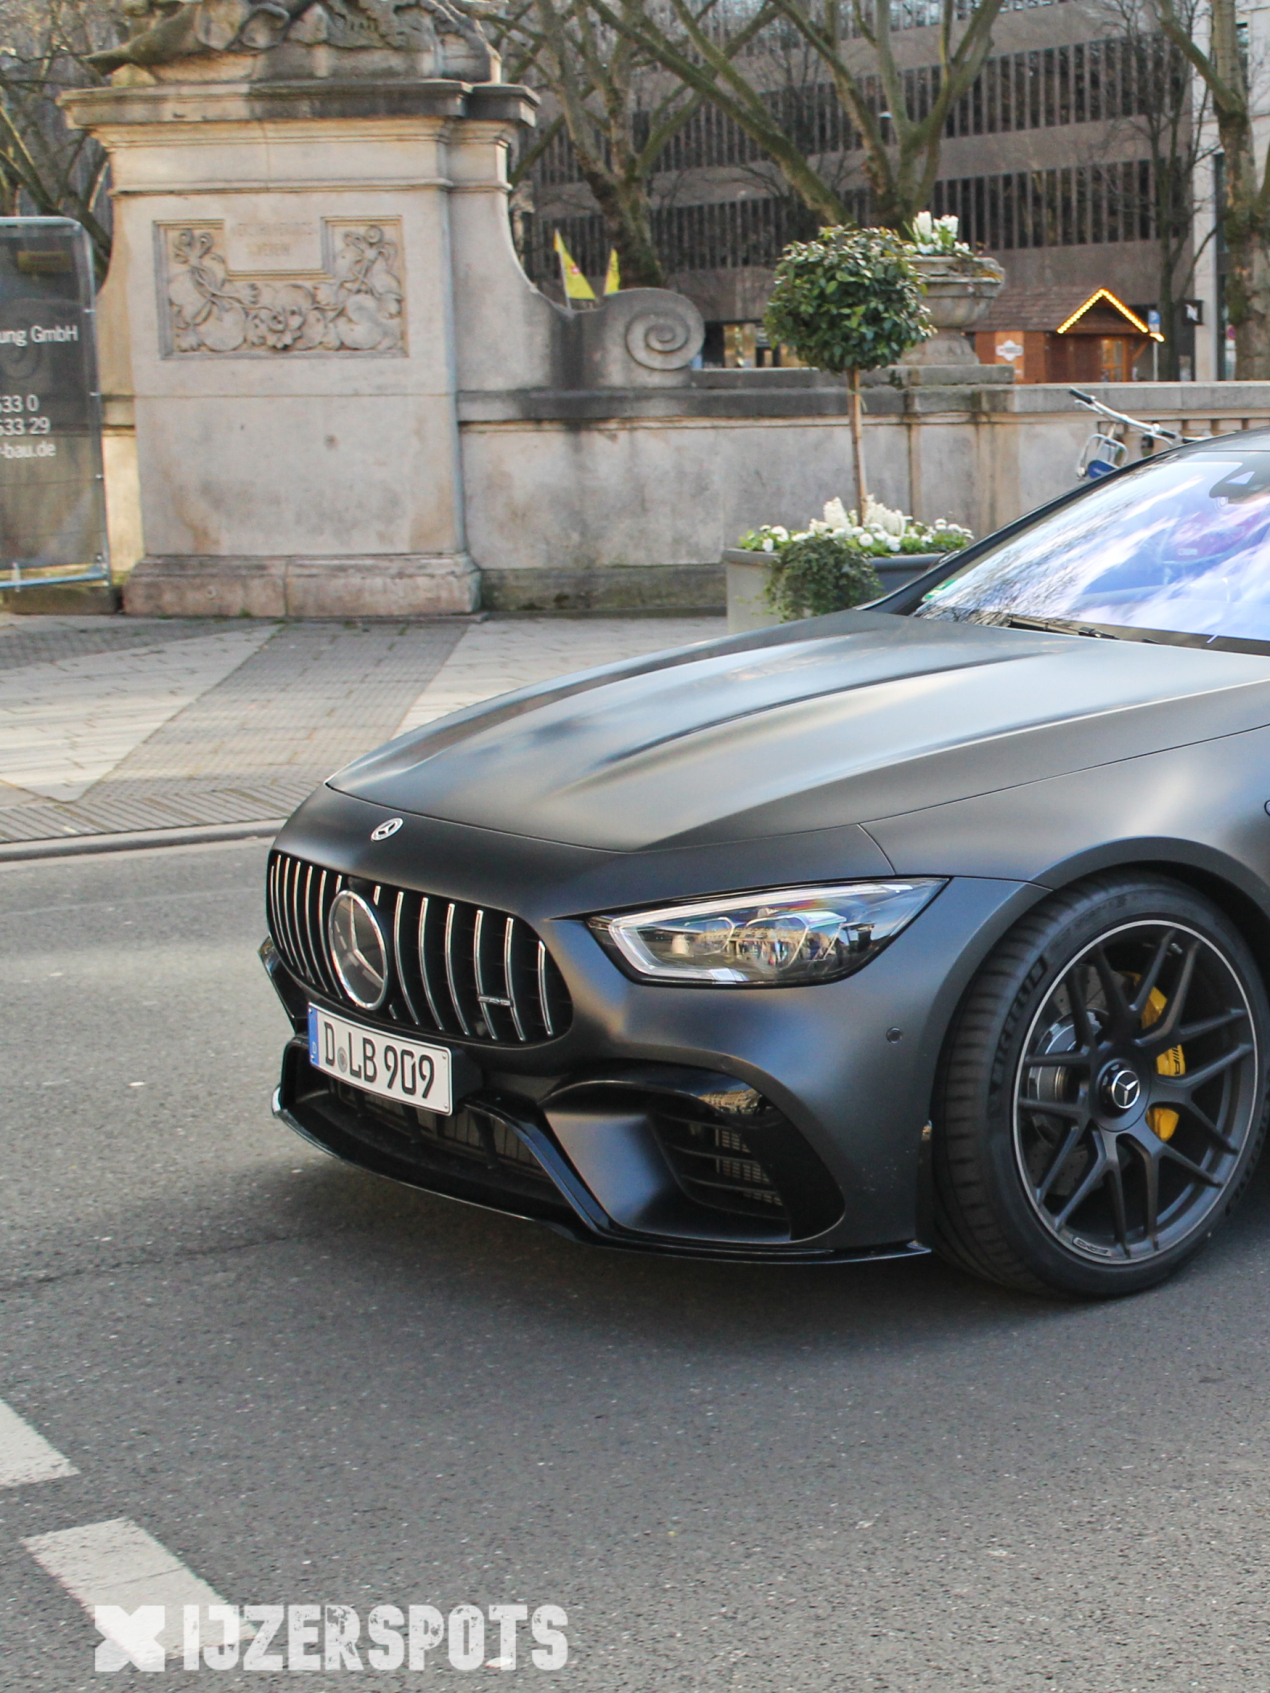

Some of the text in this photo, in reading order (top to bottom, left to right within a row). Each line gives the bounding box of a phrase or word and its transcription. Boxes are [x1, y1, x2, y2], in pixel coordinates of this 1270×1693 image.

[30, 324, 78, 343] GmbH
[27, 394, 39, 412] 0
[29, 416, 51, 434] 29
[324, 1021, 435, 1099] D LB 909
